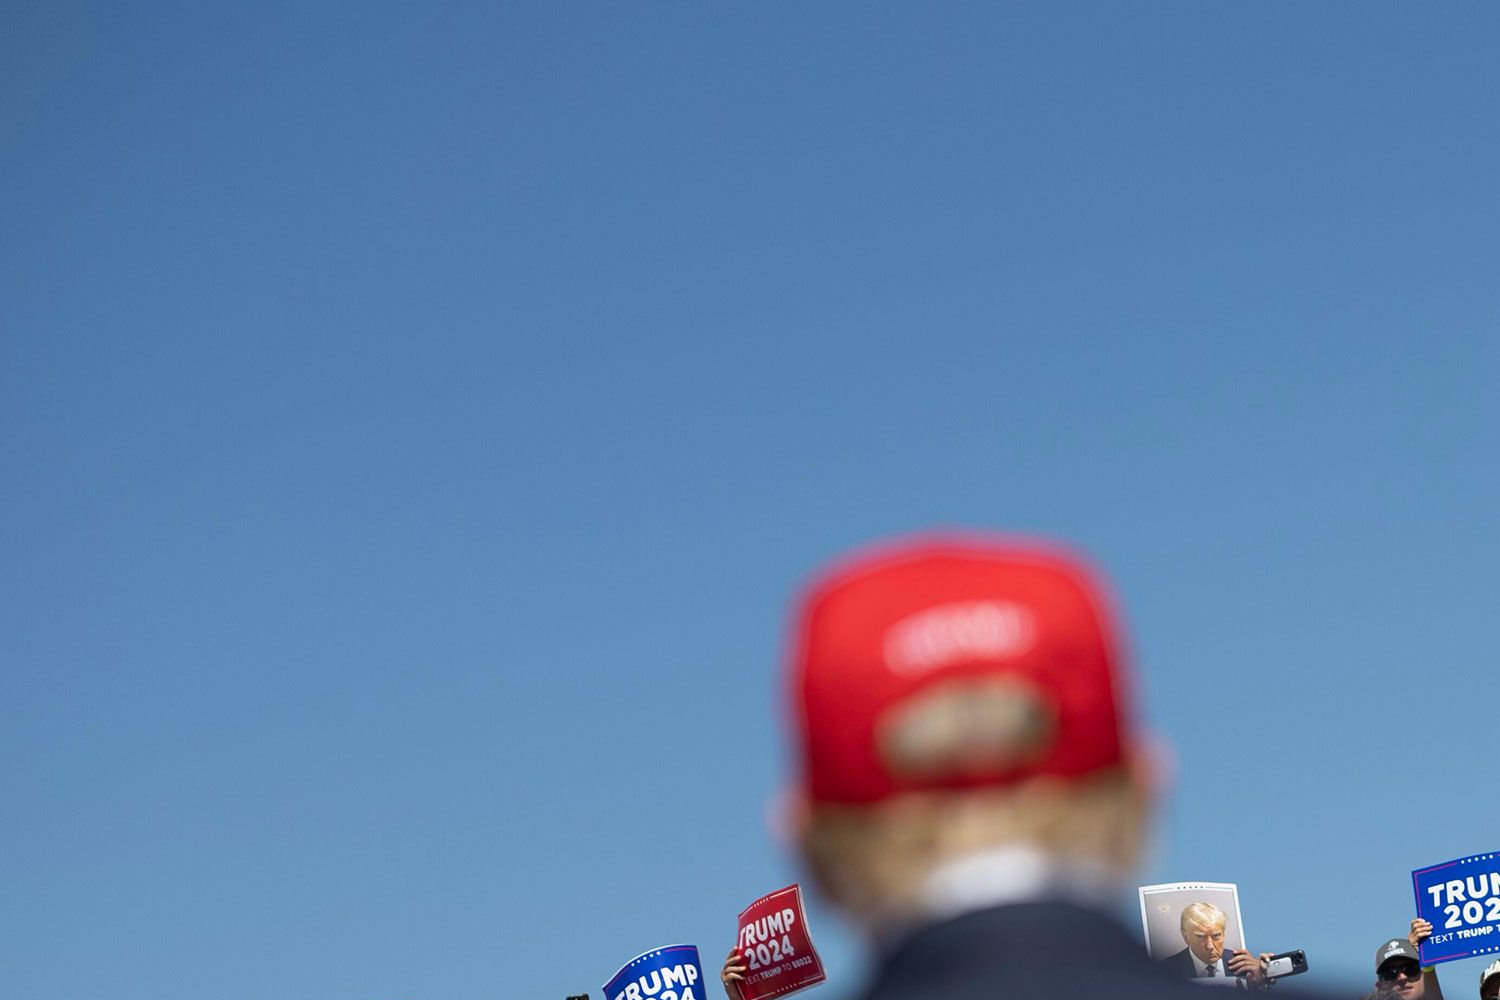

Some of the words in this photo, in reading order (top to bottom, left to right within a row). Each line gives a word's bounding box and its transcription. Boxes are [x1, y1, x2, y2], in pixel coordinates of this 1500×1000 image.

[739, 908, 795, 949] TRUMP
[1429, 931, 1454, 945] TEXT
[1456, 924, 1493, 940] TRUMP
[744, 935, 795, 971] 2024
[760, 966, 783, 980] TRUMP
[782, 963, 793, 972] TO
